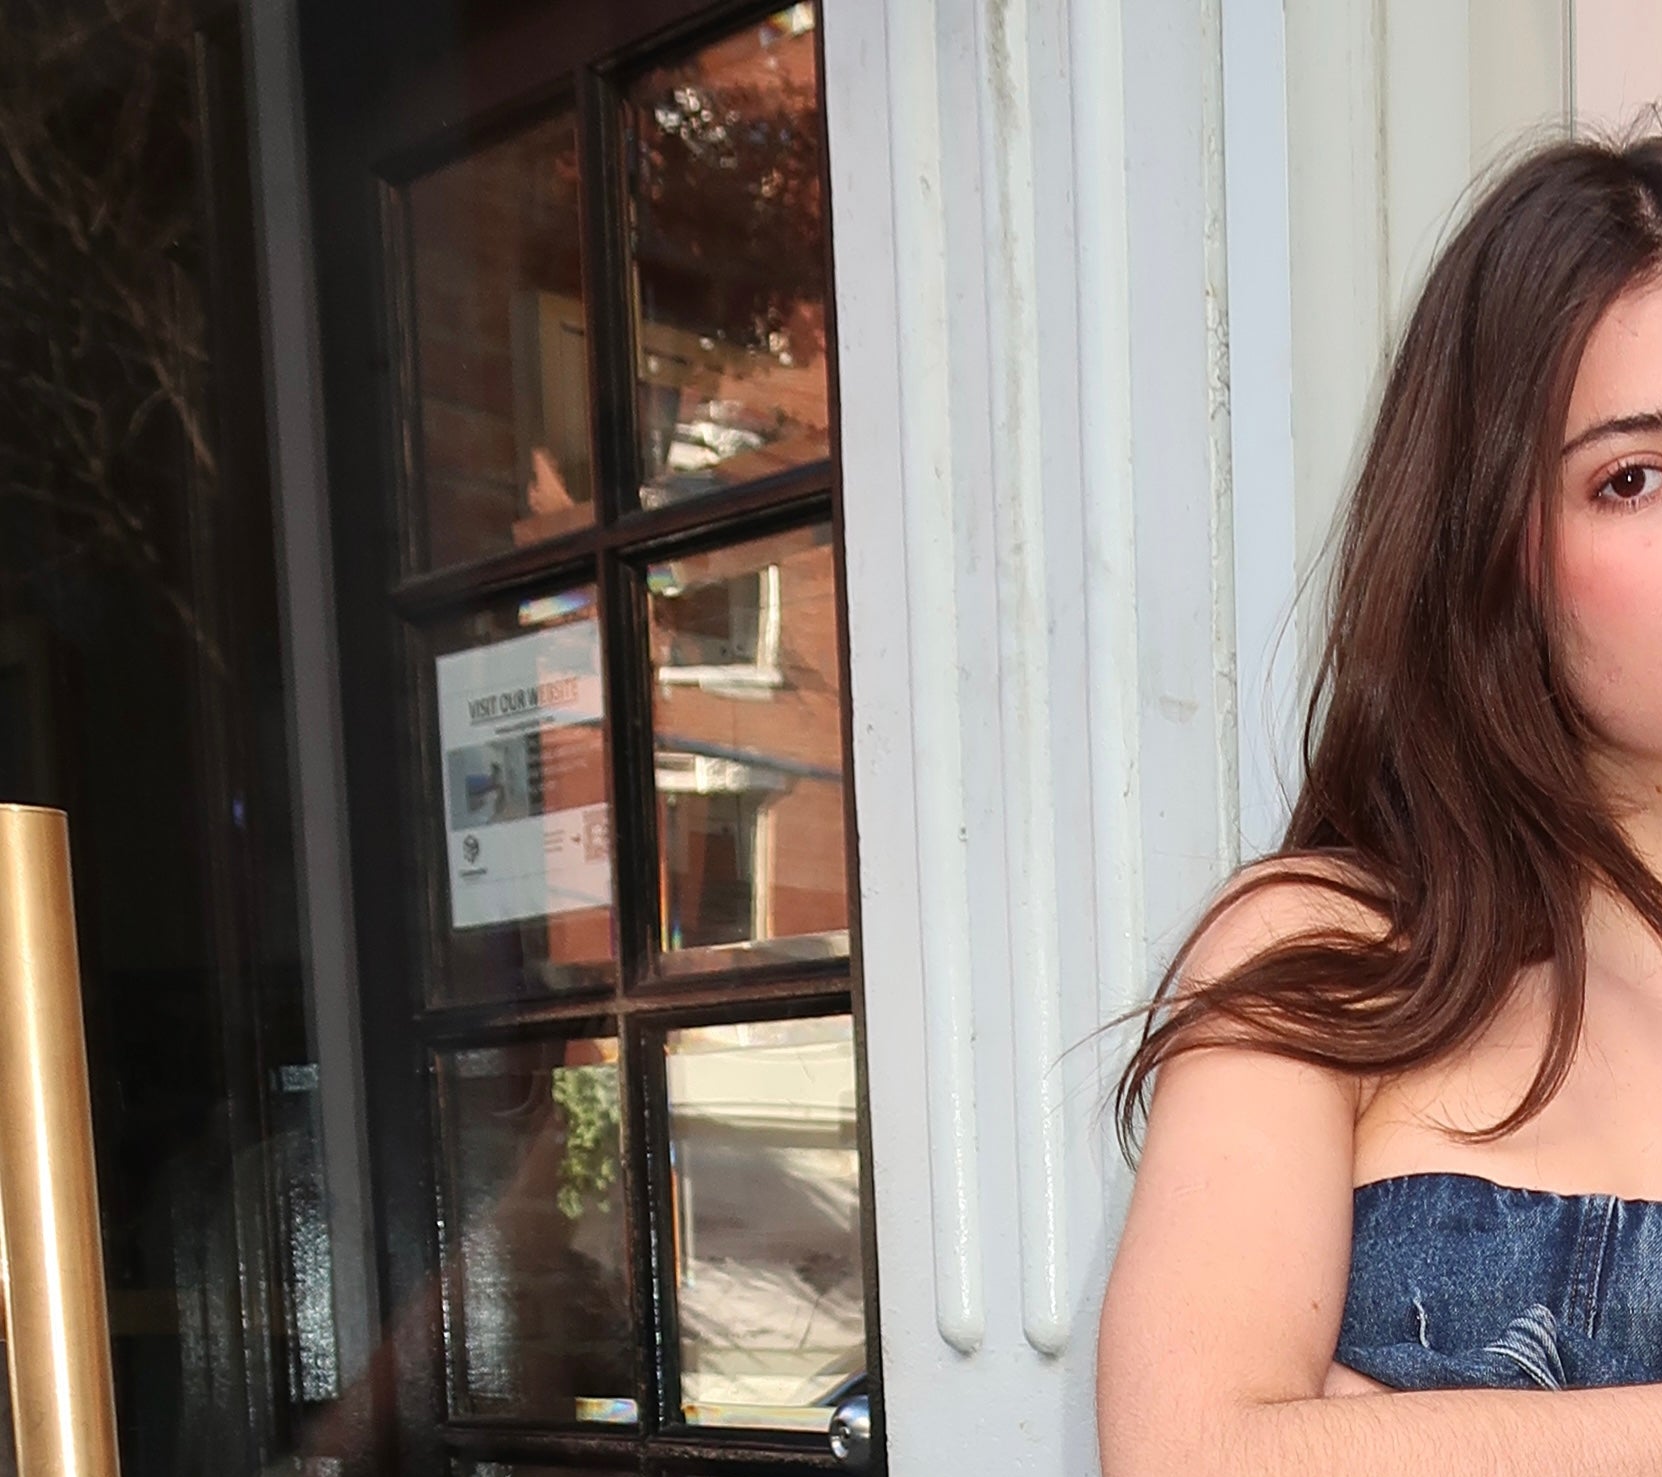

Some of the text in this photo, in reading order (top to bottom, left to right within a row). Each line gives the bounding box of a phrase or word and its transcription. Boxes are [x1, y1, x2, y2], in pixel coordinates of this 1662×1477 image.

[468, 677, 579, 718] VISIT OUR WEBSITE
